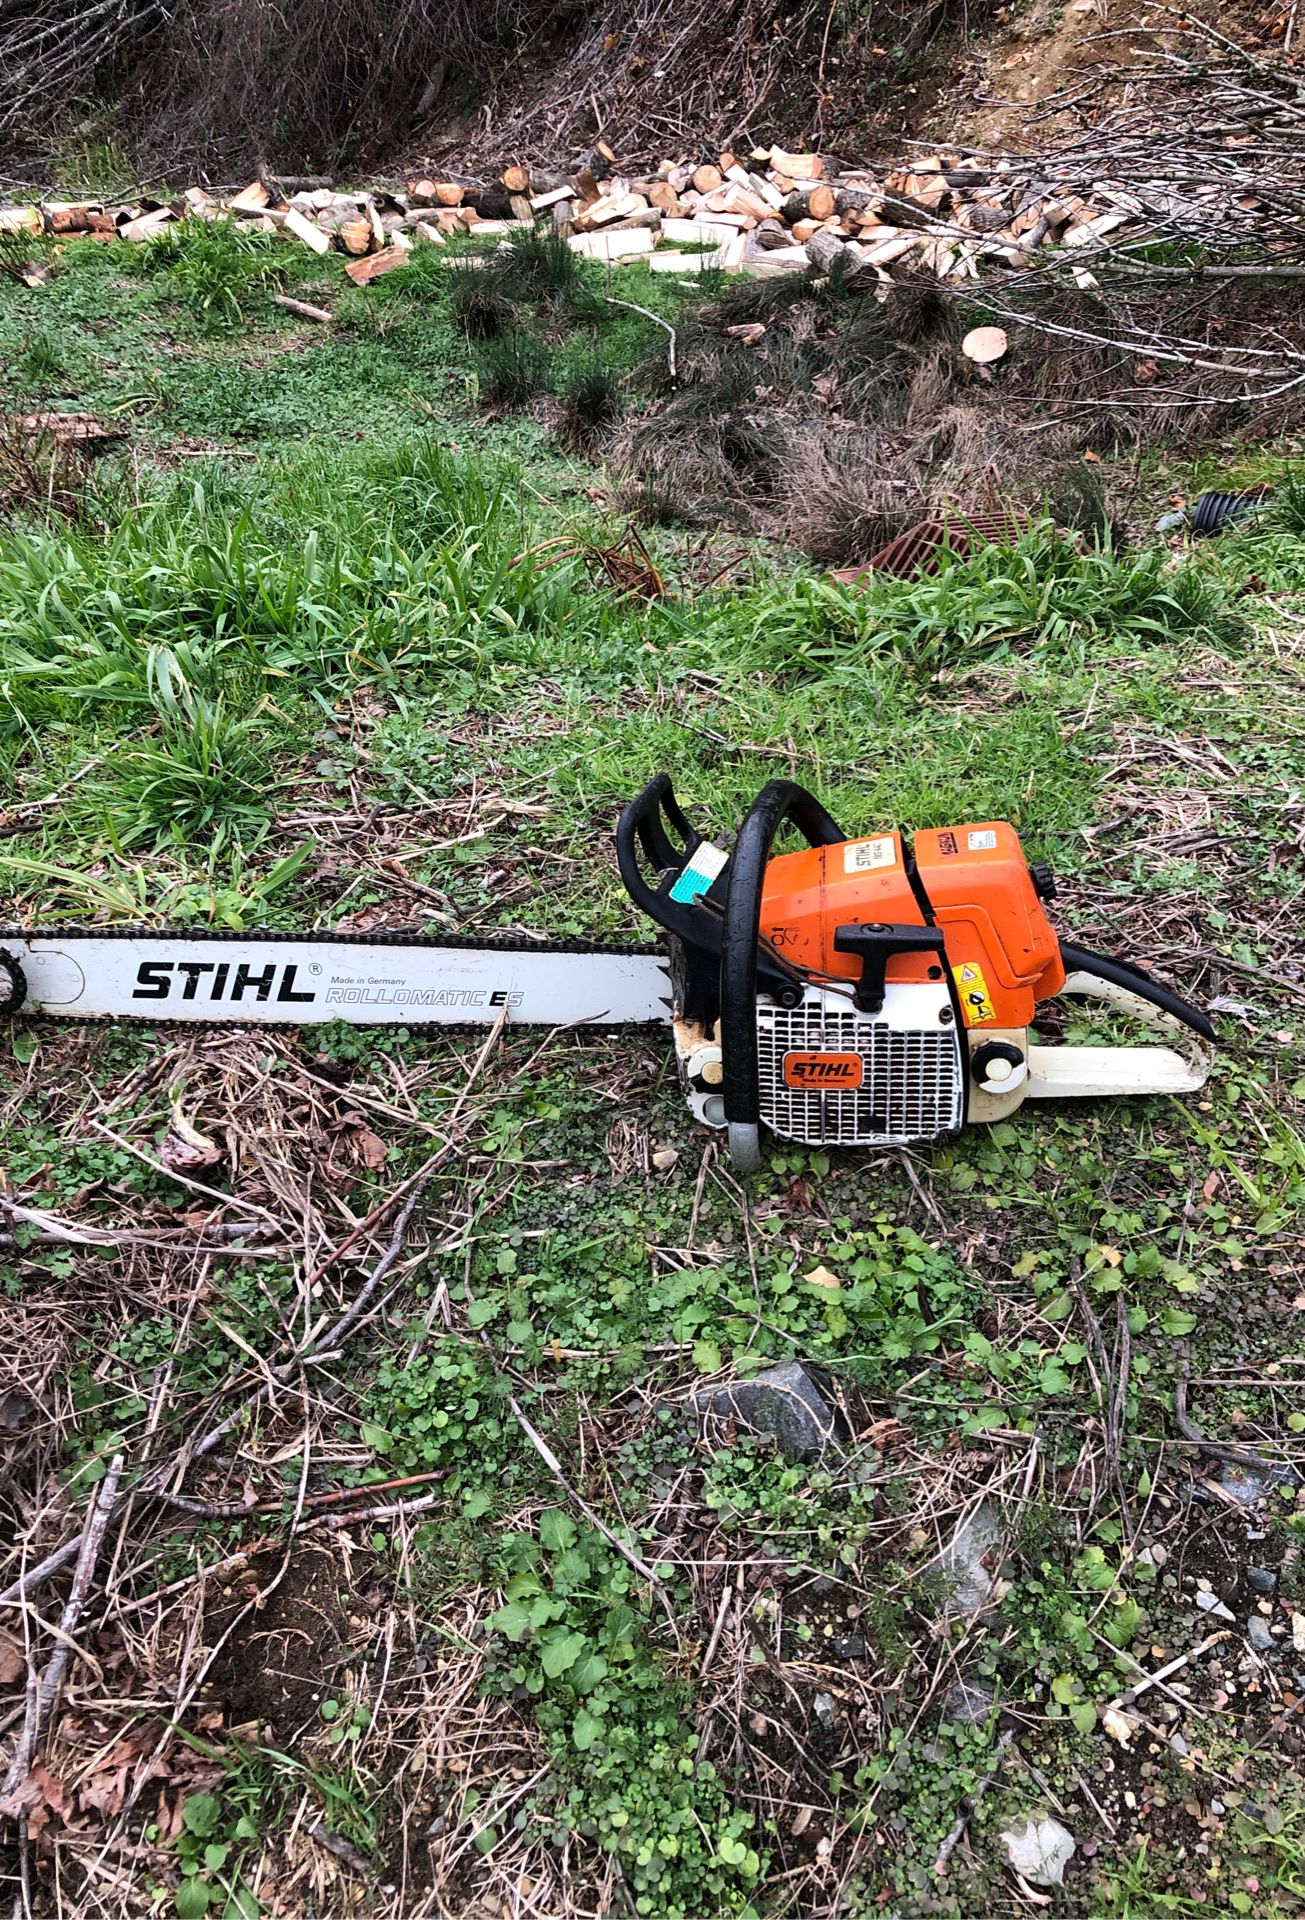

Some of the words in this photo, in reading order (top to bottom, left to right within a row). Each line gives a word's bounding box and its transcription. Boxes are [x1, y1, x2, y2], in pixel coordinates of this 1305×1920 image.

[856, 843, 871, 866] STIHL
[330, 976, 355, 985] Made
[357, 976, 365, 985] in
[367, 976, 406, 987] Germany
[325, 988, 487, 1007] ROLLOMATIC
[488, 991, 525, 1008] ES
